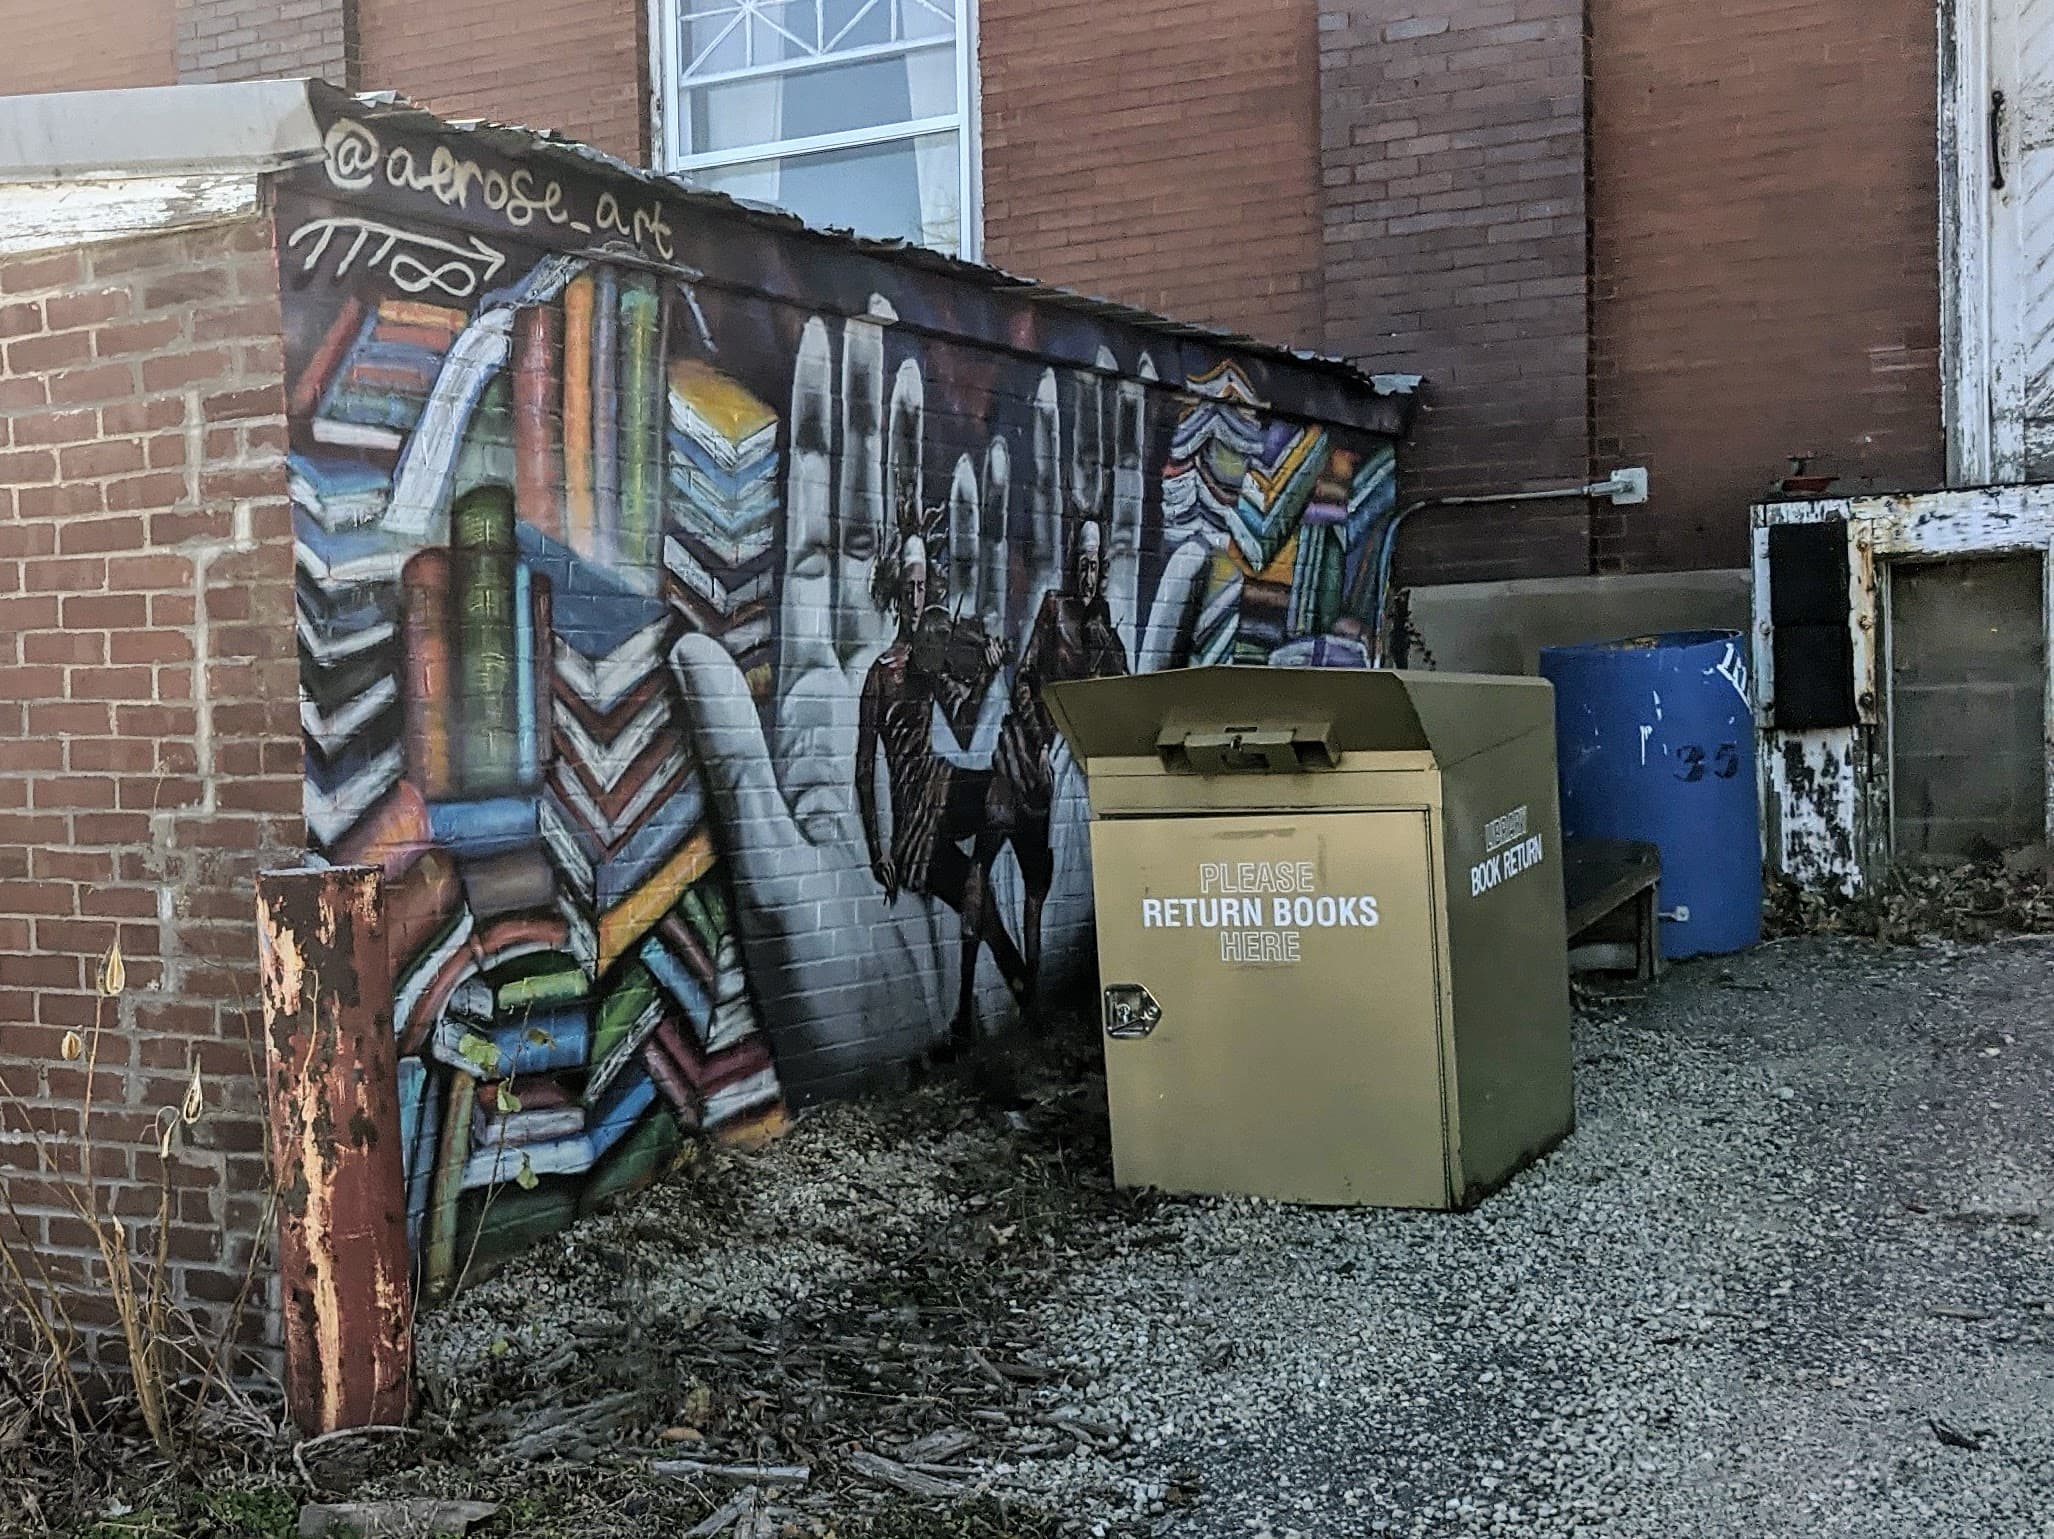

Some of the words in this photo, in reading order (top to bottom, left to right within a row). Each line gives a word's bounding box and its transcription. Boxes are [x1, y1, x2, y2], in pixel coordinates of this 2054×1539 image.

[1200, 861, 1315, 894] PLEASE
[1471, 854, 1501, 897] BOOK
[1503, 833, 1543, 880] RETURN
[1142, 897, 1263, 928] RETURN
[1273, 895, 1380, 927] BOOKS
[1220, 931, 1301, 962] HERE
